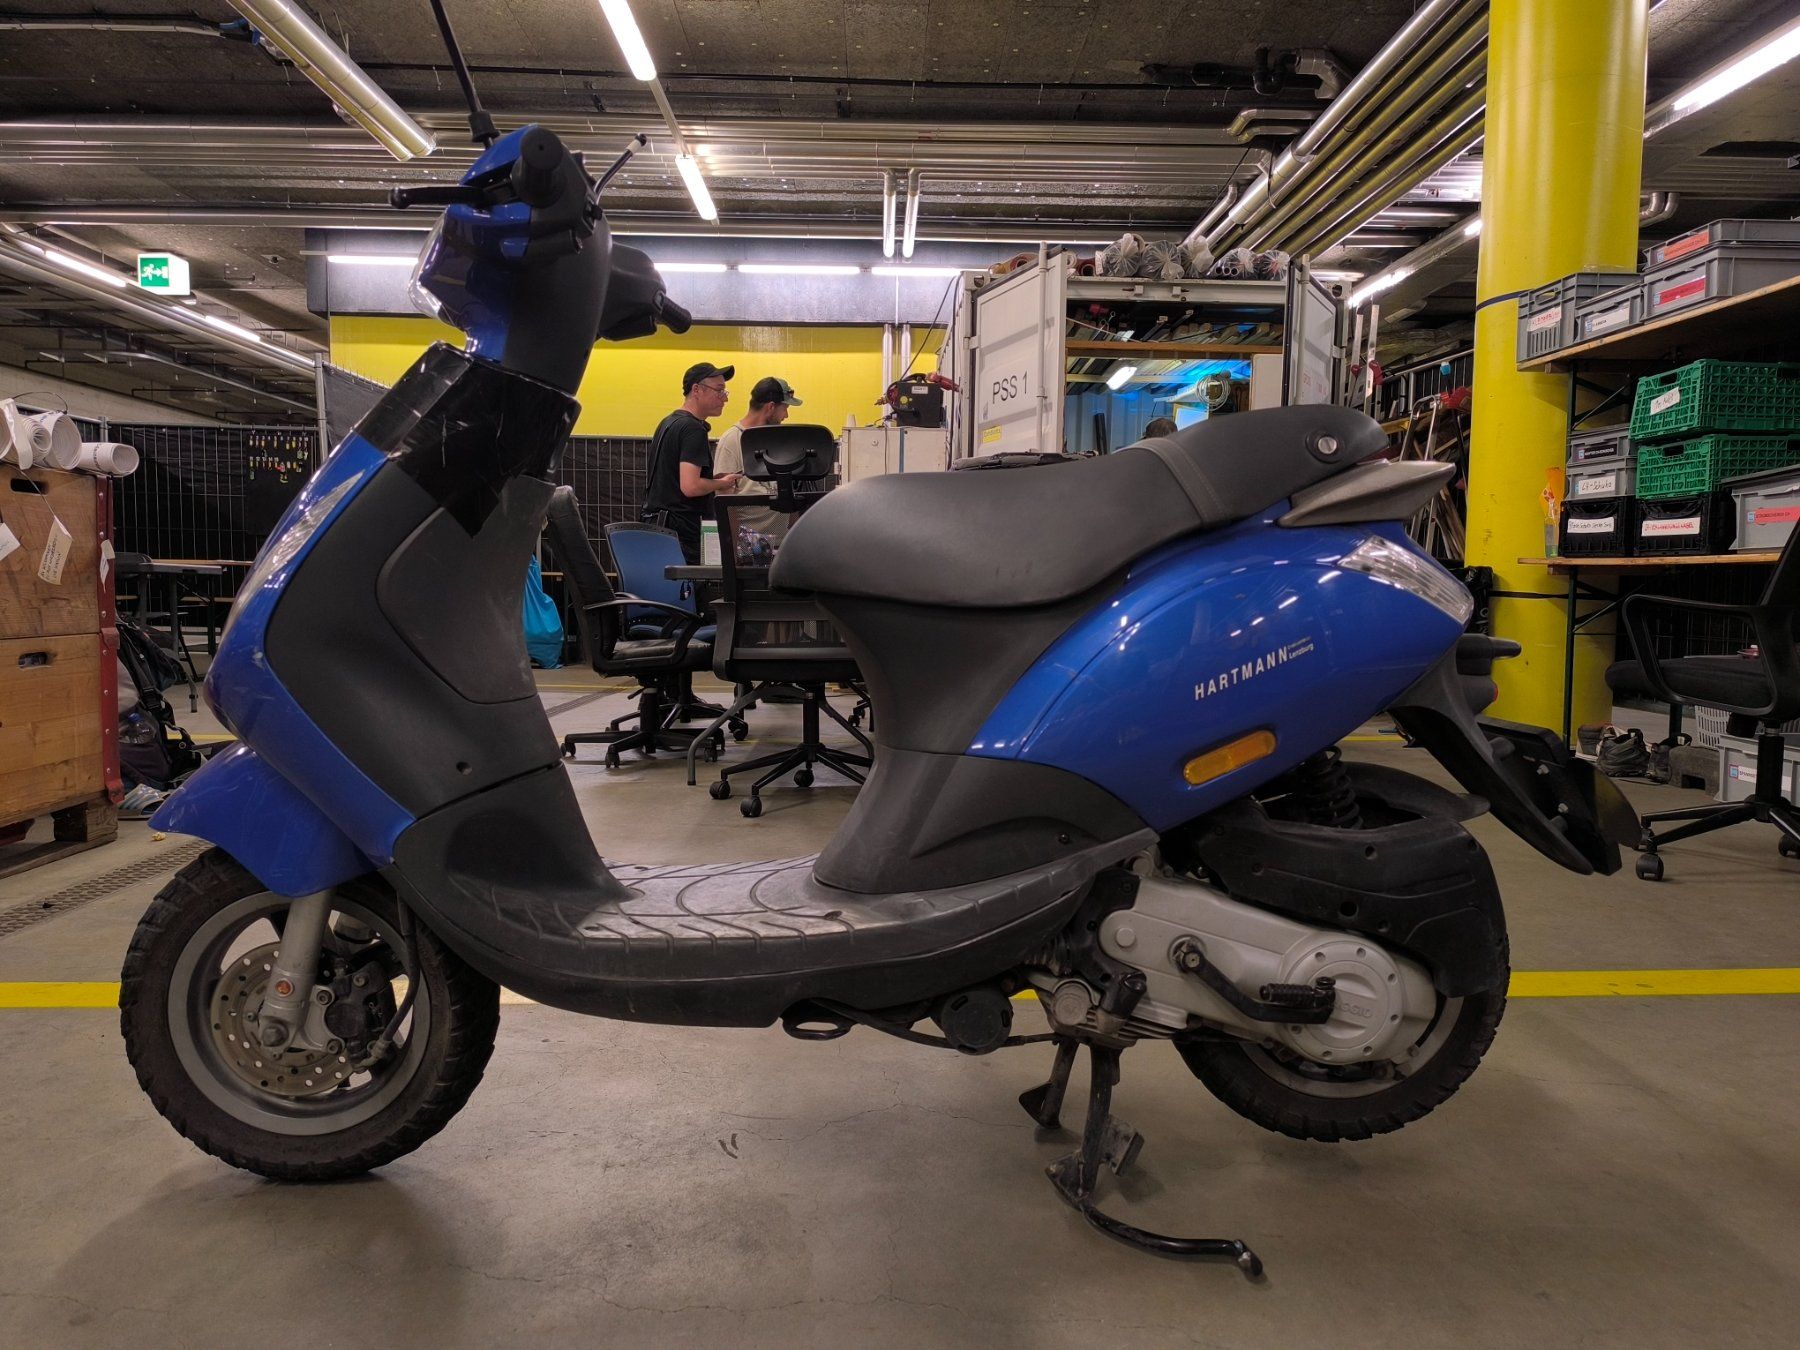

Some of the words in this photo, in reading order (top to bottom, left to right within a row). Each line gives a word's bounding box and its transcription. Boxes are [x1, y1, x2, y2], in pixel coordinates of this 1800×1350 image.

[992, 375, 1017, 404] PSS
[1022, 370, 1028, 394] 1
[1194, 646, 1288, 700] HARTMANN
